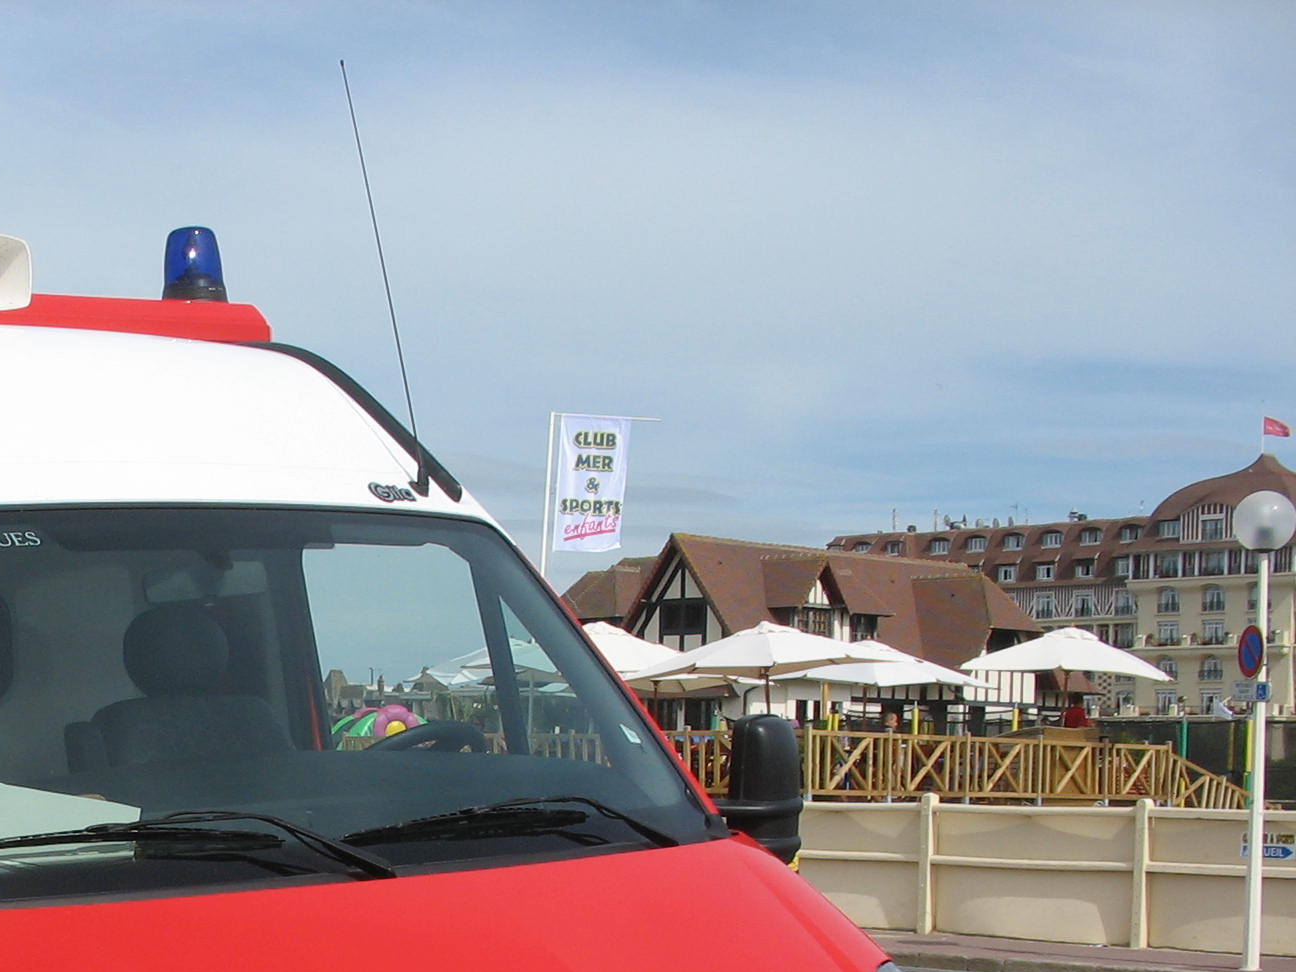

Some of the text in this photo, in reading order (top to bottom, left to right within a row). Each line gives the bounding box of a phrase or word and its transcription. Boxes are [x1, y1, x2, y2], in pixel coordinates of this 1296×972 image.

[573, 431, 617, 449] CLUB
[573, 454, 614, 472] MER
[584, 476, 600, 495] &
[560, 498, 623, 517] SPORTS
[564, 514, 619, 541] enfants
